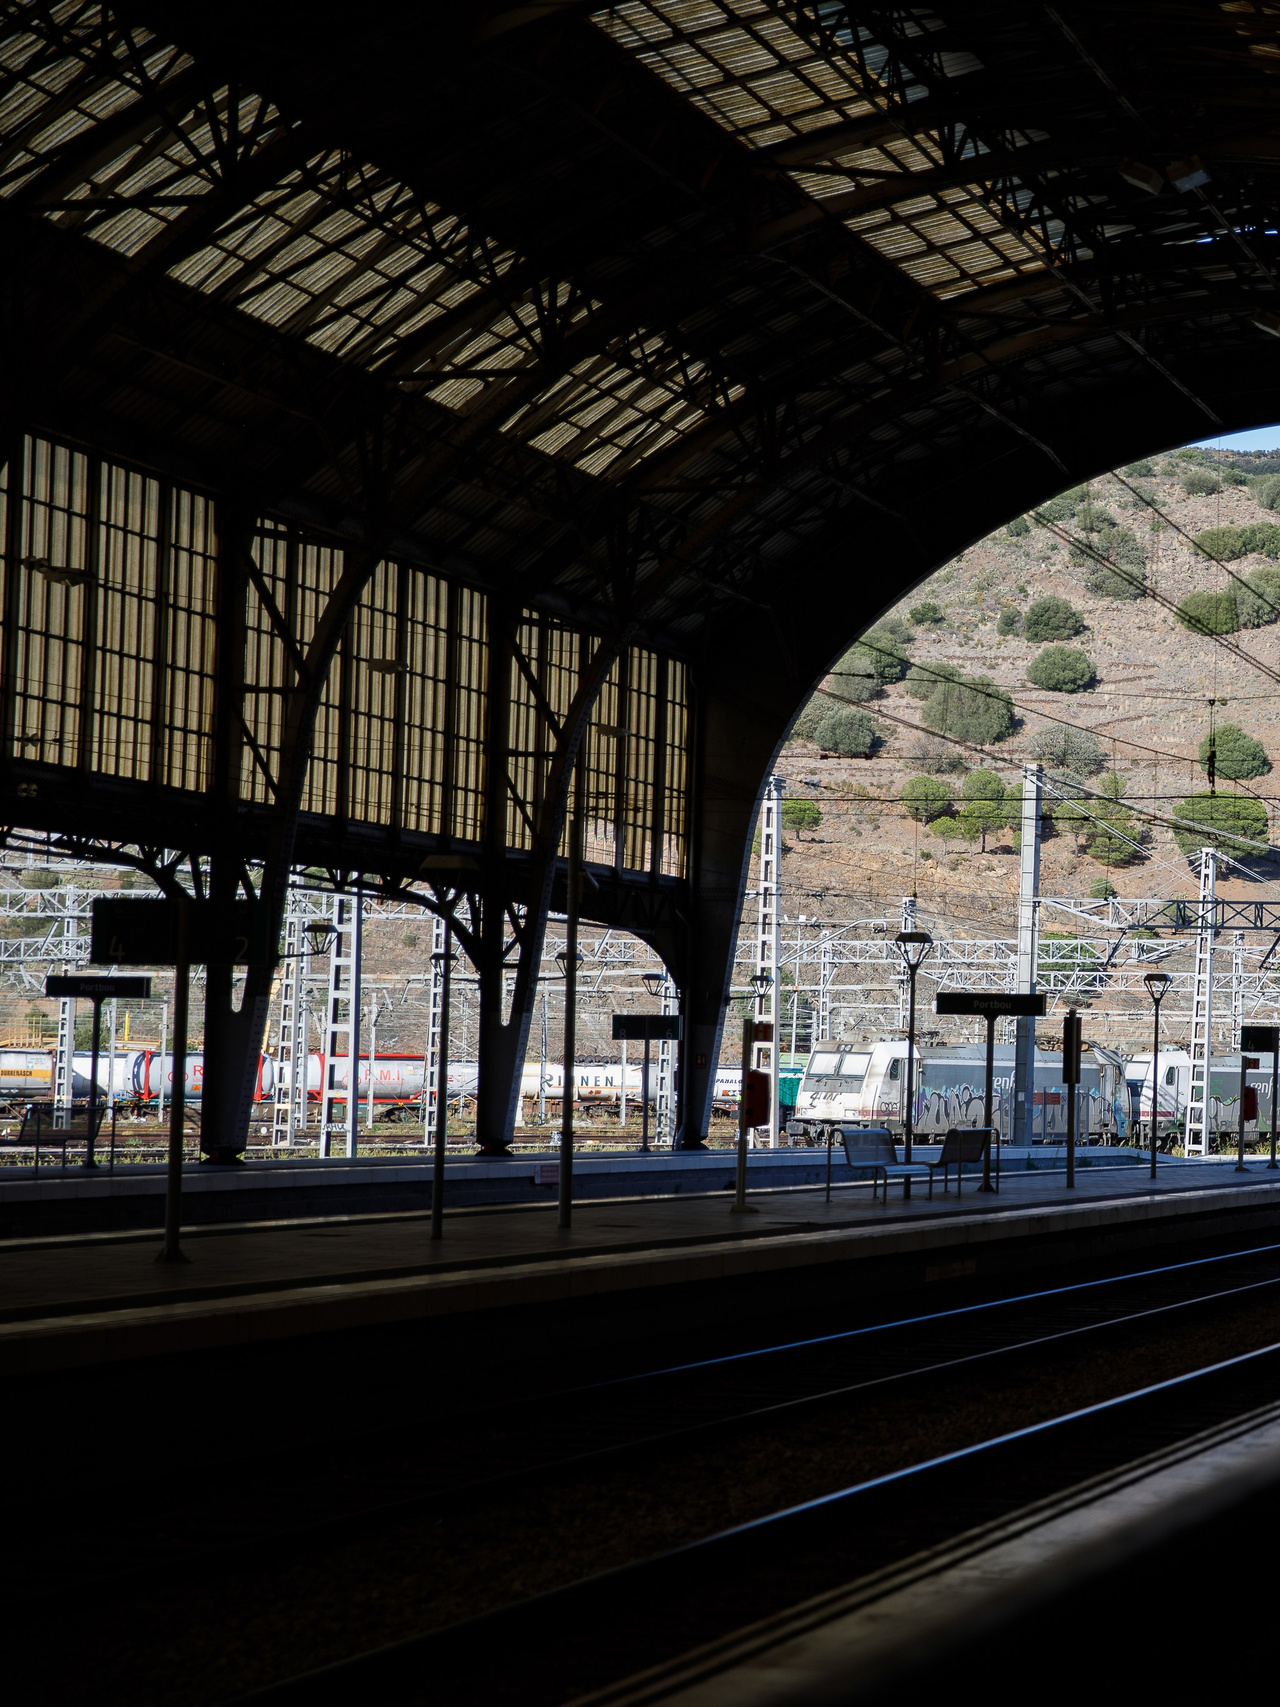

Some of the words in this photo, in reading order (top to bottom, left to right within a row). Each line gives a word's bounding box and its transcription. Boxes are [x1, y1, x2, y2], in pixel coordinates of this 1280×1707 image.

[108, 935, 126, 962] 4
[235, 936, 249, 963] 2
[80, 982, 115, 992] Portbou
[973, 999, 1012, 1009] Portbou
[619, 1028, 626, 1039] 8
[665, 1028, 673, 1039] 6
[541, 1074, 614, 1088] RINEN
